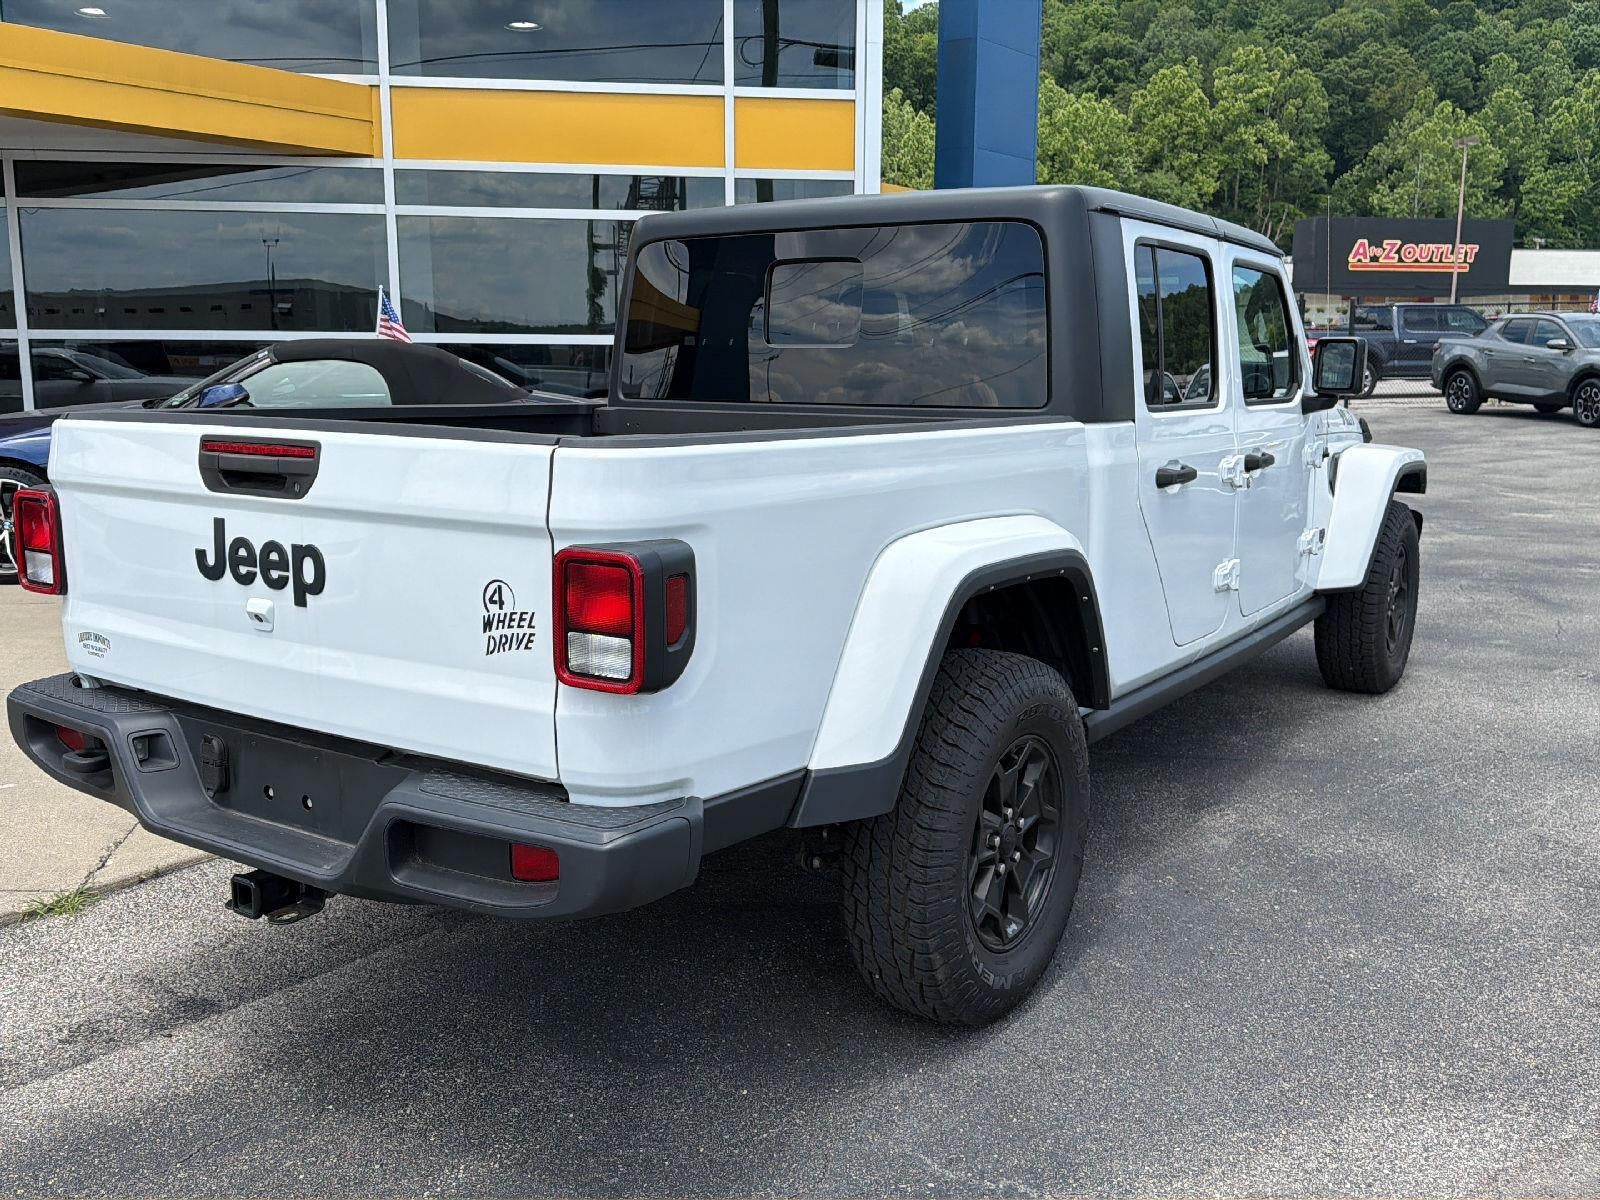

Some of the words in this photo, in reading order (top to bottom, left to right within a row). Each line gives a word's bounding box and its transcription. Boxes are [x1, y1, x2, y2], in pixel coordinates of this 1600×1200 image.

[1401, 243, 1479, 263] OUTLET
[195, 516, 326, 608] Jeep
[488, 584, 505, 611] 4
[482, 611, 536, 634] WHEEL
[486, 632, 536, 656] DRIVE
